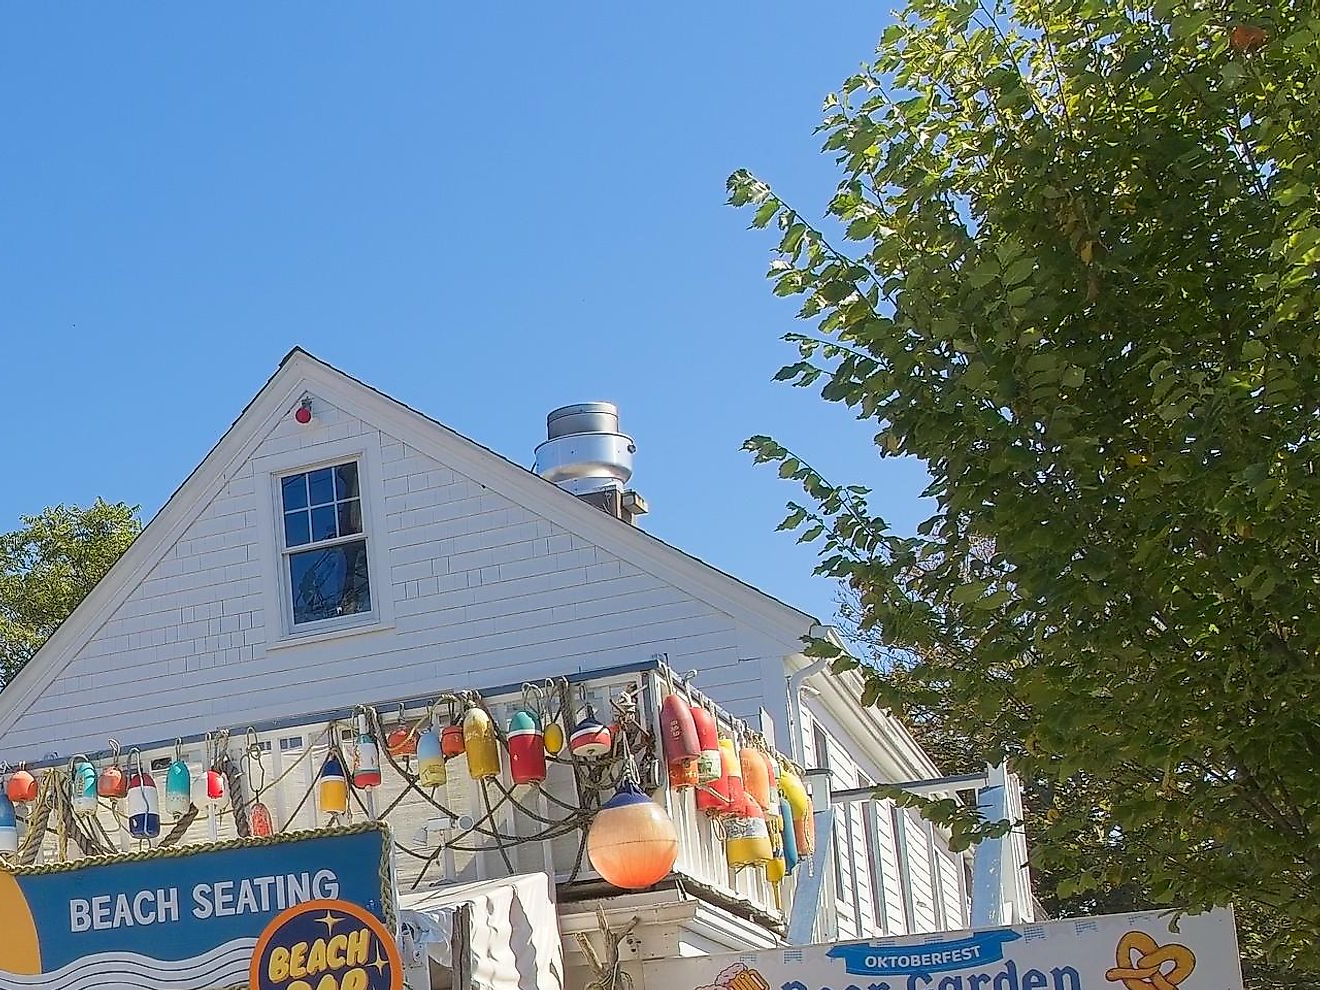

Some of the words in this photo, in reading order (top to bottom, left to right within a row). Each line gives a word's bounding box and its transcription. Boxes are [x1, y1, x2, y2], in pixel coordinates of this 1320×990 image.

[69, 886, 179, 933] BEACH
[191, 868, 340, 920] SEATING
[268, 928, 370, 984] BEACH
[864, 945, 982, 969] OKTOBERFEST
